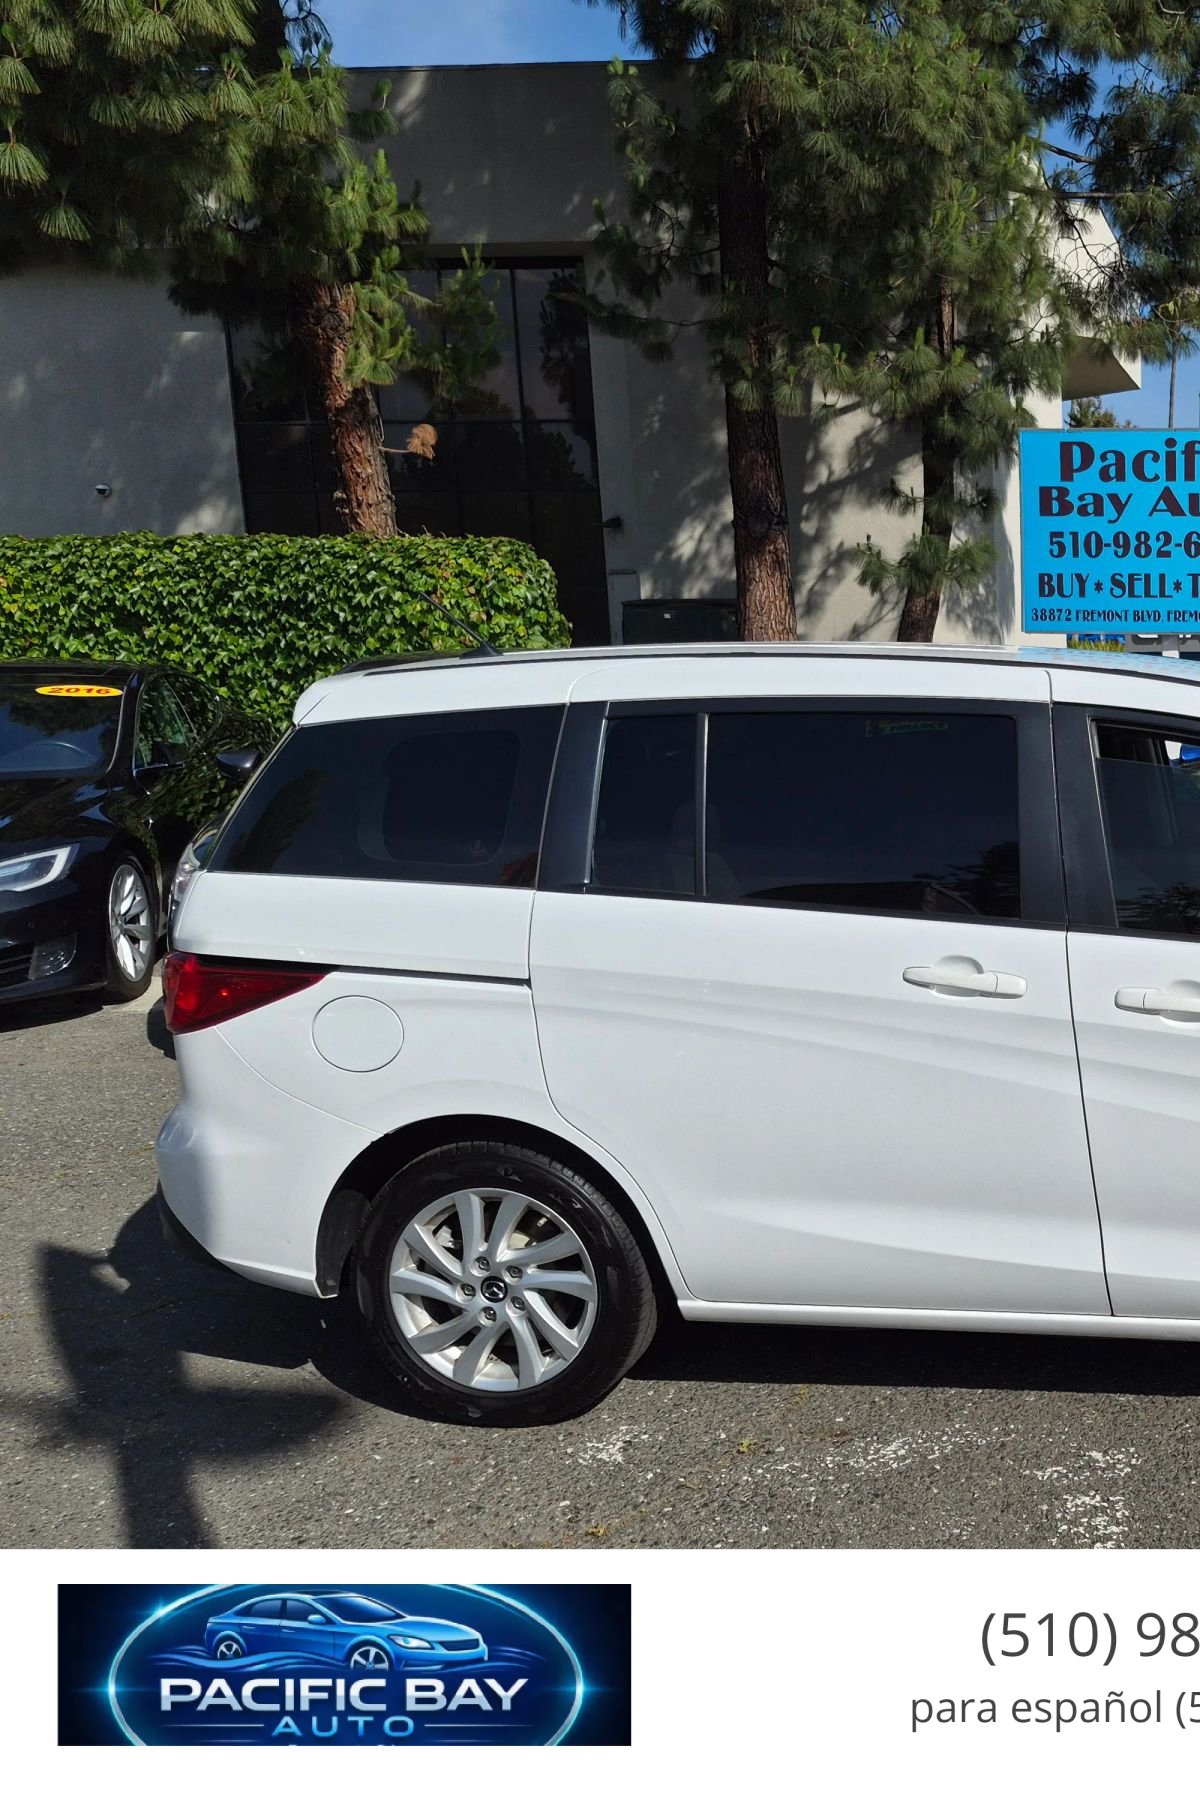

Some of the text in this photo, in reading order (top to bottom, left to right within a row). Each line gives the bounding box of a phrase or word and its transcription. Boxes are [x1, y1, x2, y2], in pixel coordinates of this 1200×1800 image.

[1039, 485, 1133, 524] Bay
[1038, 572, 1090, 599] BUY
[1031, 608, 1072, 622] 38872
[1075, 609, 1129, 622] FREMONT
